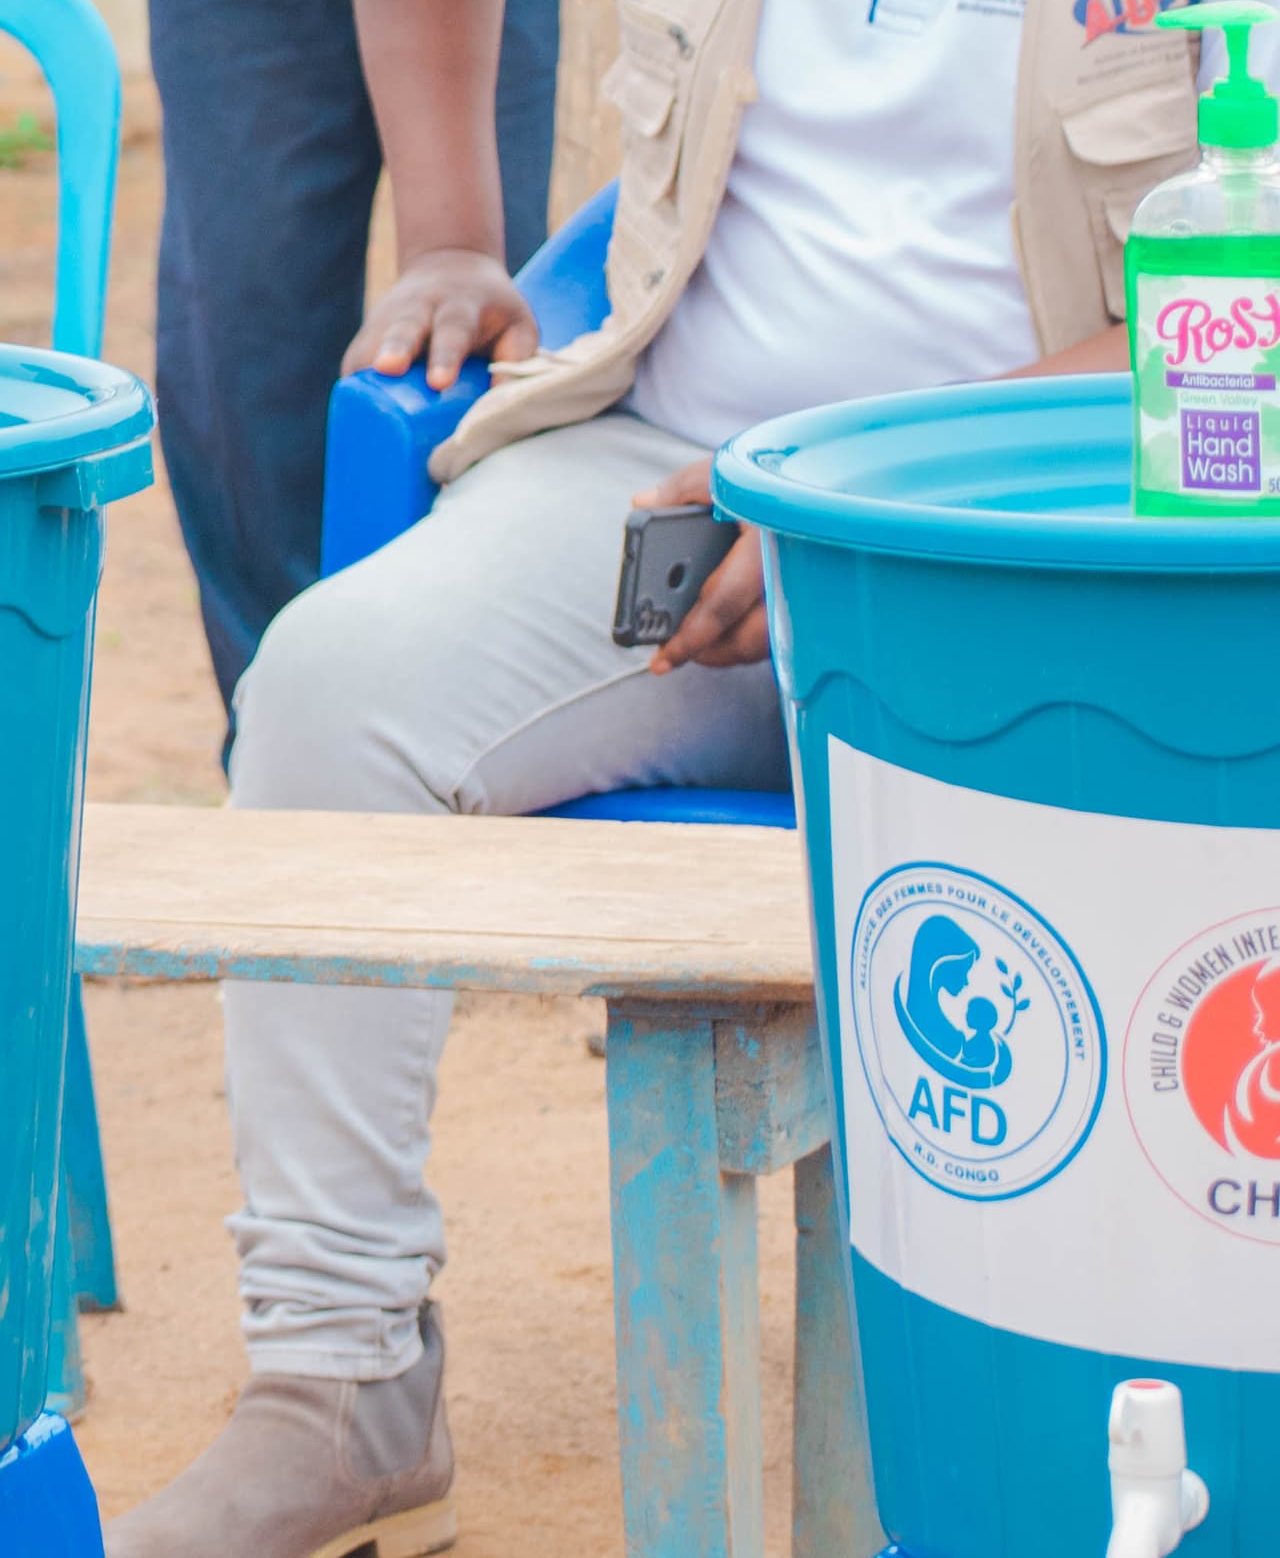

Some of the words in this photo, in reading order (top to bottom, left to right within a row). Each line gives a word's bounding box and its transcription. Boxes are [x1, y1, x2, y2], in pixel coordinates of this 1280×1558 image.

[1181, 374, 1255, 388] Antibacterial
[1180, 392, 1216, 405] Green
[1219, 393, 1258, 408] Valley
[1186, 414, 1252, 433] Liquid
[1187, 431, 1252, 457] Hand
[1187, 456, 1253, 483] Wash
[875, 896, 894, 919] DES
[894, 882, 944, 901] FEMMES
[947, 884, 987, 909] POUR
[991, 905, 1010, 924] LE
[1165, 944, 1236, 1010] WOMEN
[1157, 1012, 1183, 1029] &
[1150, 1032, 1179, 1093] CHILD
[908, 1075, 1008, 1147] AFD
[914, 1143, 939, 1168] R.D.
[944, 1161, 1000, 1182] CONGO
[1207, 1178, 1280, 1218] CH
